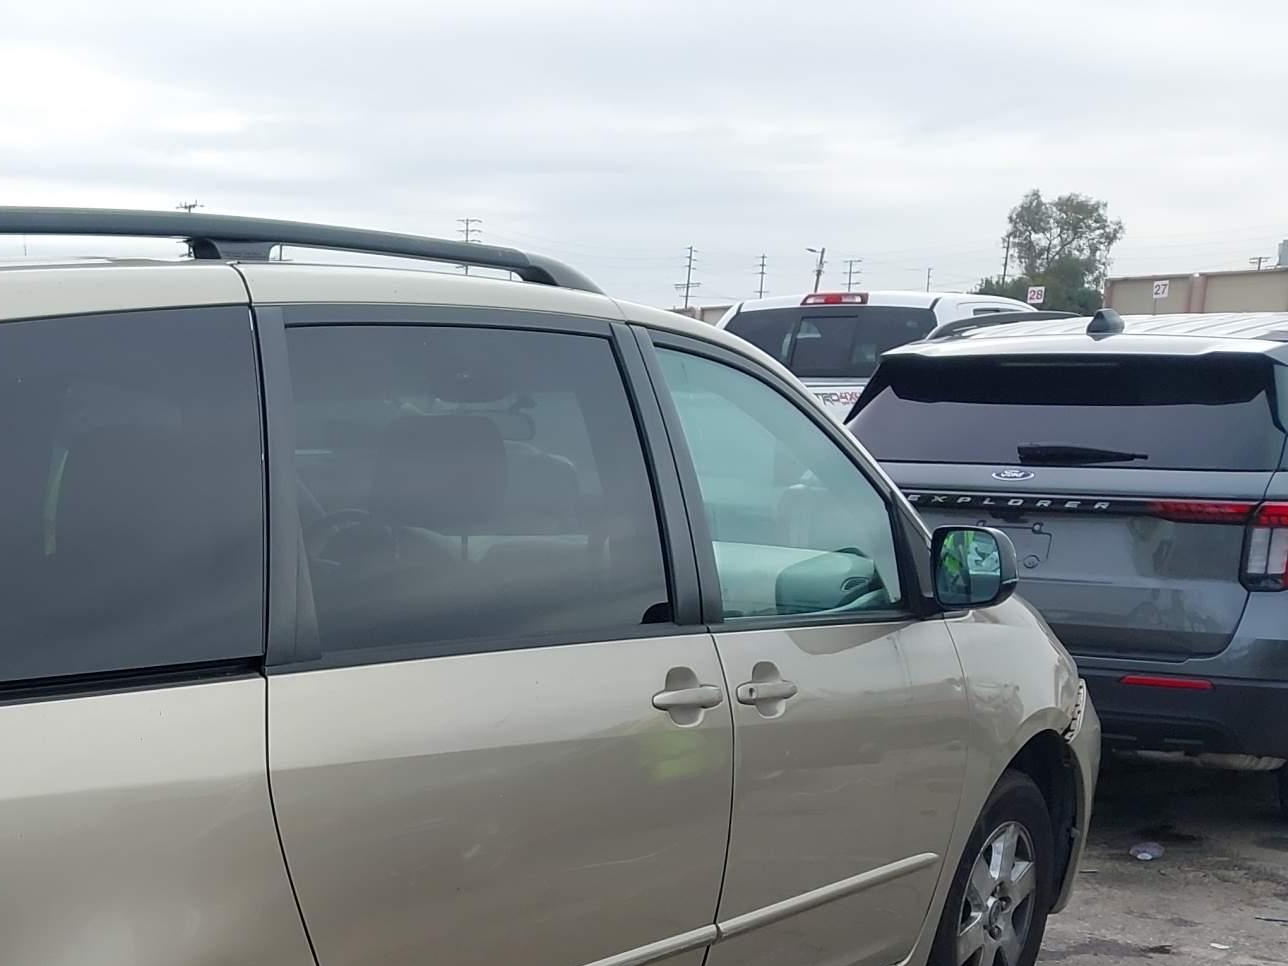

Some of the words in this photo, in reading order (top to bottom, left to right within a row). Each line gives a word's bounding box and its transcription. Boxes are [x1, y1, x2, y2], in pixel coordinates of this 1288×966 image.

[1028, 289, 1043, 301] 28
[1154, 283, 1168, 296] 27
[907, 494, 1110, 510] EXPLORER
